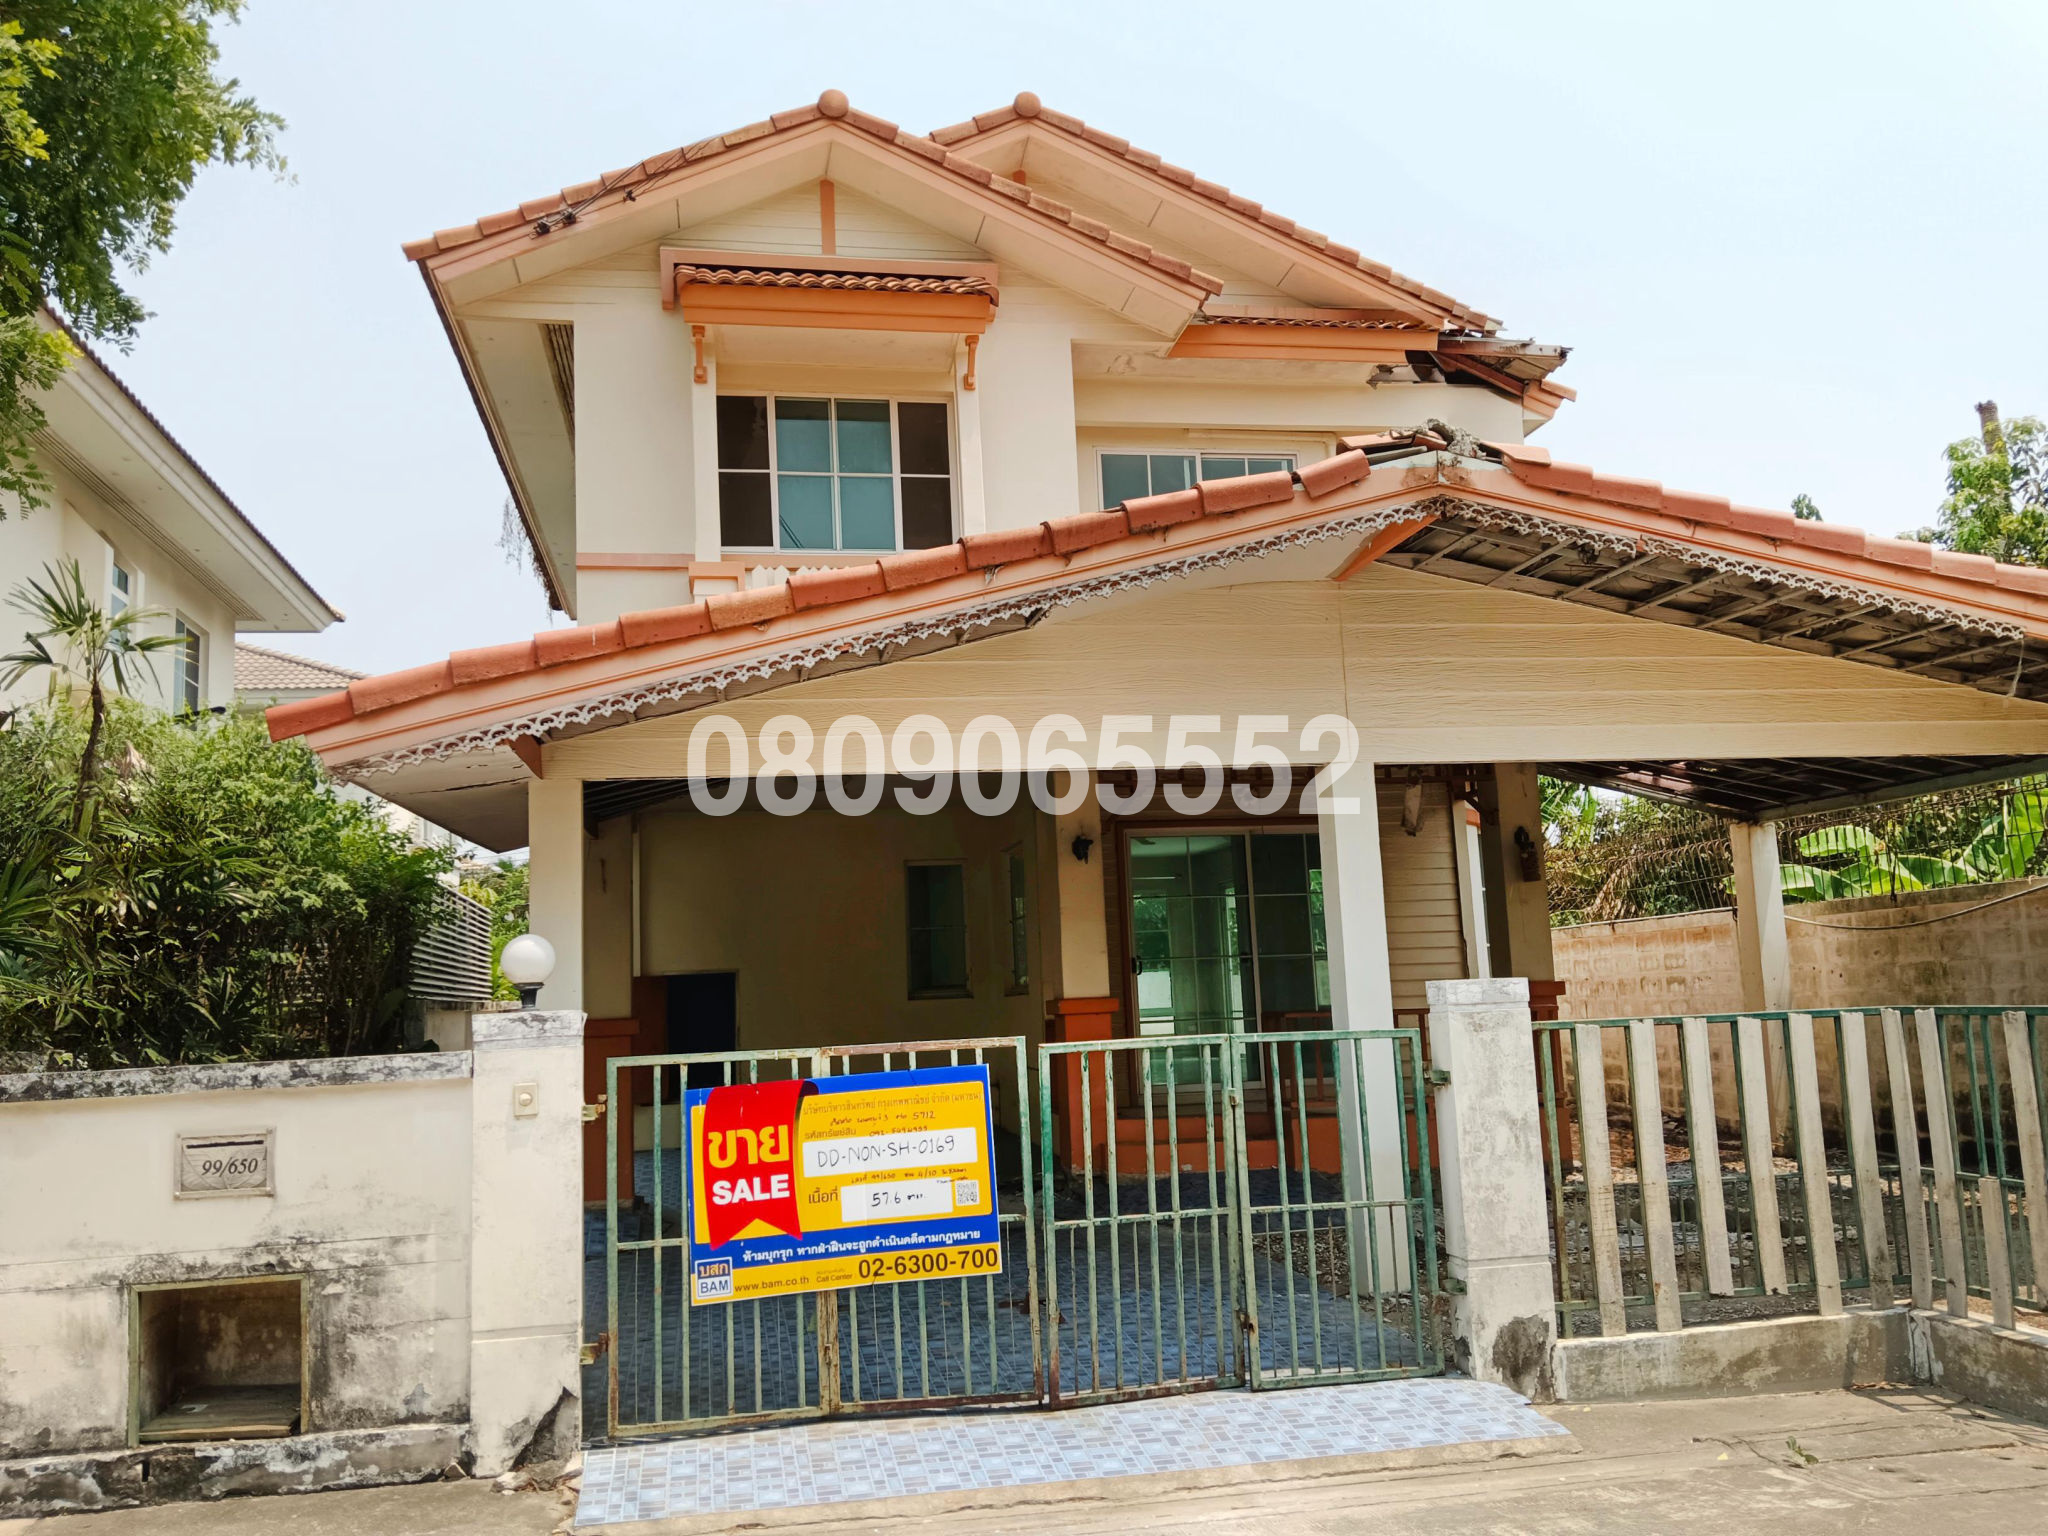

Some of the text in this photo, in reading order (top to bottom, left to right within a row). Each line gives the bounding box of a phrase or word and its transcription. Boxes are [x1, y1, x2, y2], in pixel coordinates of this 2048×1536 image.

[913, 1110, 936, 1120] 5712
[708, 1124, 790, 1169] ขาย
[817, 1135, 955, 1168] DD-NON-SH-0169
[201, 1156, 258, 1177] 99/650
[712, 1174, 790, 1205] SALE
[808, 1186, 839, 1204] เนื้อที่
[743, 1230, 981, 1264] ห้ามบุกรุก หากฝ่าฝืนจะถูกดำเนินคดีตามกฎหมาย
[699, 1262, 729, 1277] บสก
[858, 1248, 998, 1279] 02-6300-700
[700, 1280, 729, 1294] BAM
[735, 1276, 809, 1292] www.bam.co.th
[816, 1273, 853, 1283] Call Center
